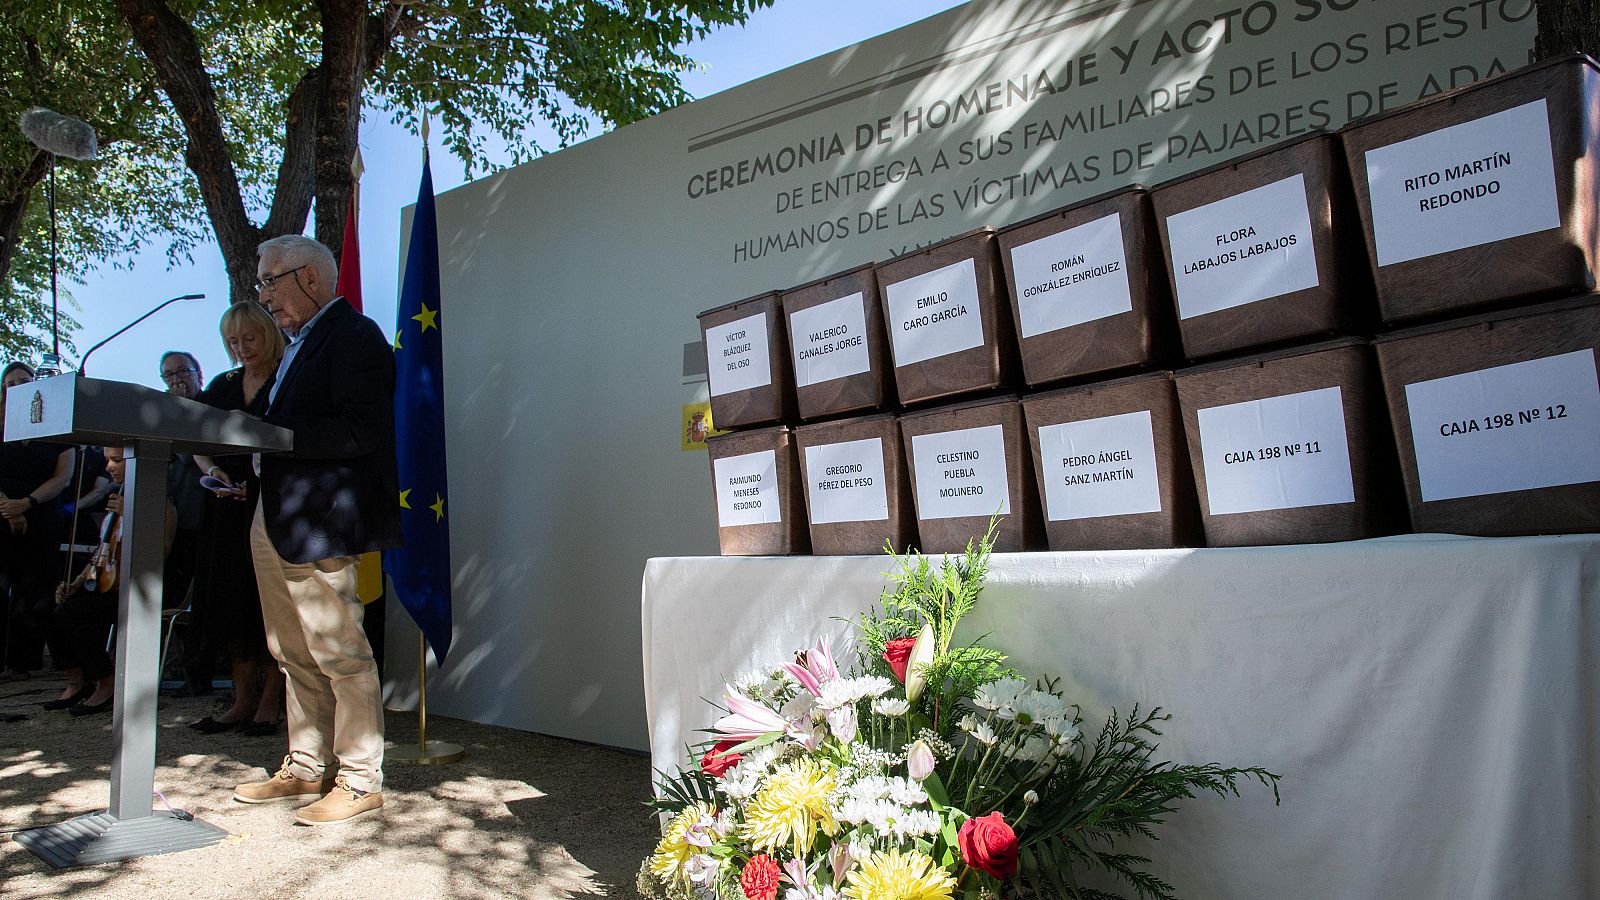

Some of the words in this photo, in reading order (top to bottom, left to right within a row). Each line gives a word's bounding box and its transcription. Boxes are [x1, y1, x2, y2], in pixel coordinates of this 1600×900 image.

[687, 132, 847, 199] CEREMONIA
[855, 115, 894, 155] DE
[903, 52, 1098, 139] HOMENAJE
[1110, 38, 1140, 75] Y
[1151, 0, 1277, 66] ACTO
[776, 187, 804, 214] DE
[811, 156, 923, 205] ENTREGA
[931, 148, 950, 174] A
[958, 126, 1013, 165] SUS
[1023, 75, 1215, 150] FAMILIARES
[1229, 57, 1277, 96] DE
[1291, 33, 1369, 80] LOS
[734, 216, 849, 263] HUMANOS
[858, 200, 890, 234] DE
[896, 193, 944, 226] LAS
[954, 154, 1100, 211] VÍCTIMAS
[1113, 141, 1154, 176] DE
[1166, 100, 1332, 164] PAJARES
[1347, 82, 1398, 120] DE
[1404, 172, 1440, 192] RITO
[1445, 152, 1511, 181] MARTÍN
[1419, 181, 1500, 212] REDONDO
[1216, 226, 1256, 246] FLORA
[1051, 254, 1084, 273] ROMÁN
[1184, 251, 1237, 274] LABAJOS
[1240, 234, 1297, 259] LABAJOS
[1023, 276, 1071, 298] GONZÁLEZ
[1072, 261, 1120, 284] ENRÍQUEZ
[917, 292, 948, 309] EMILIO
[903, 316, 929, 331] CARO
[931, 304, 967, 323] GARCÍA
[726, 330, 746, 342] VÍCTOR
[809, 324, 848, 343] VALERICO
[723, 342, 751, 357] BLÁZQUEZ
[799, 343, 834, 360] CANALES
[835, 335, 862, 351] JORGE
[727, 360, 739, 371] DEL
[739, 358, 750, 368] OSO
[1440, 419, 1480, 436] CAJA
[1484, 413, 1514, 430] 198
[1518, 408, 1540, 424] Nº
[1546, 404, 1568, 420] 12
[936, 450, 979, 464] CELESTINO
[1063, 454, 1095, 468] PEDRO
[1098, 450, 1132, 464] ÁNGEL
[1225, 450, 1255, 464] CAJA
[1258, 446, 1281, 460] 198
[1284, 443, 1301, 457] Nº
[1305, 441, 1321, 454] 11
[826, 463, 862, 476] GREGORIO
[944, 468, 976, 479] PUEBLA
[1064, 474, 1090, 486] SANZ
[1092, 466, 1134, 483] MARTÍN
[729, 474, 762, 485] RAIMUNDO
[818, 479, 839, 490] PÉREZ
[840, 479, 854, 488] DEL
[854, 477, 873, 487] PESO
[733, 487, 760, 497] MENESES
[940, 485, 983, 498] MOLINERO
[733, 500, 762, 510] REDONDO
